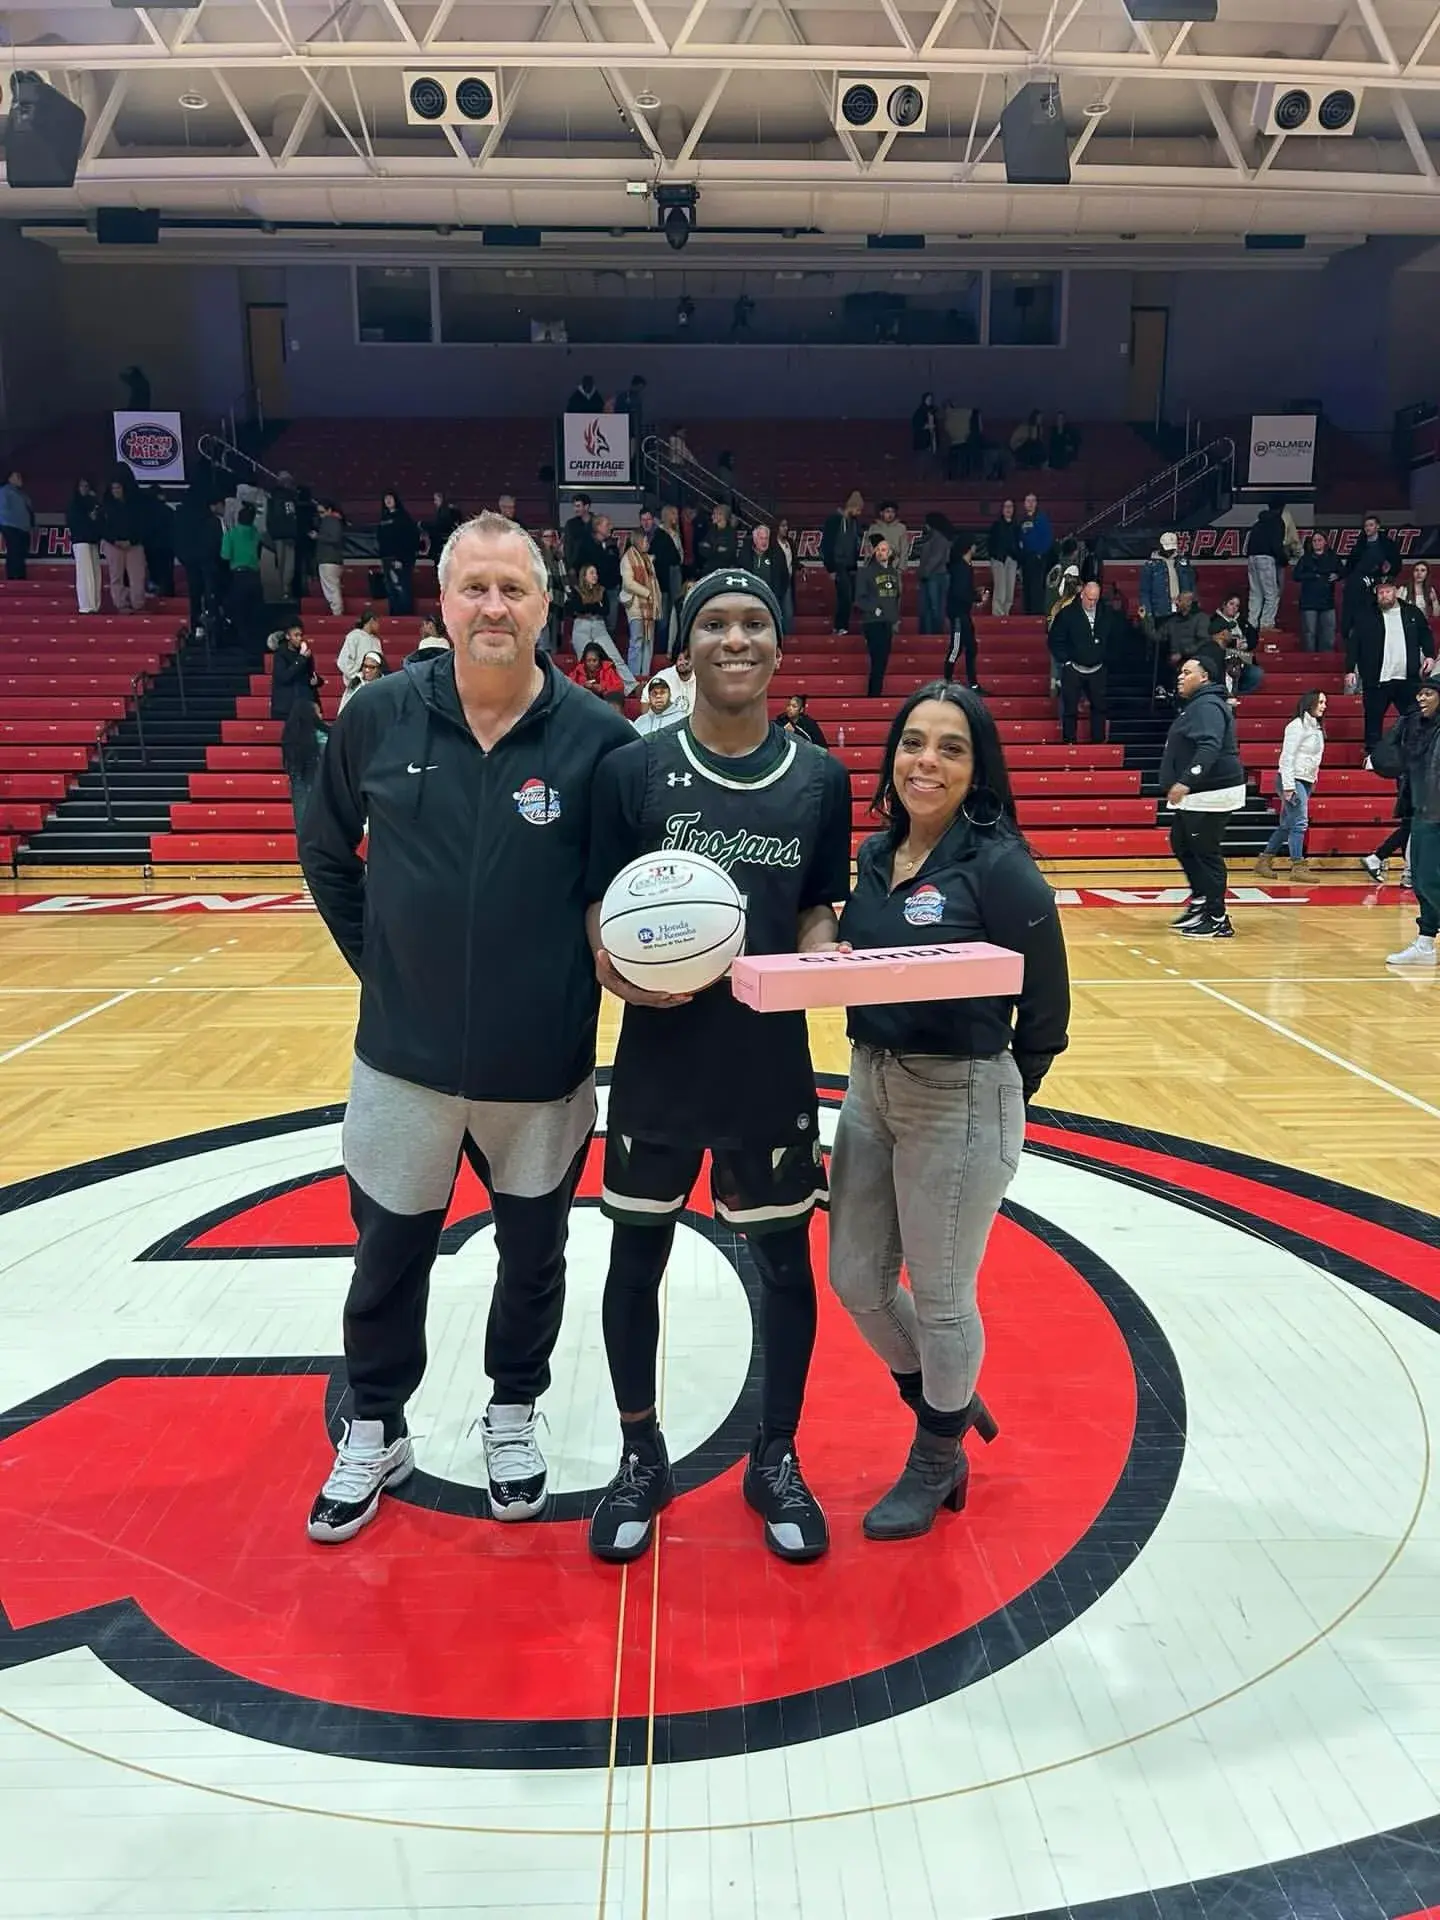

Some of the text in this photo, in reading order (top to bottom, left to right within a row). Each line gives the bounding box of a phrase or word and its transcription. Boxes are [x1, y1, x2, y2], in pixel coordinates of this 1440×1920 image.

[1268, 440, 1313, 448] PALMEN
[569, 460, 625, 470] CARTHAGE
[661, 811, 801, 873] Trojans
[659, 920, 690, 934] Honda
